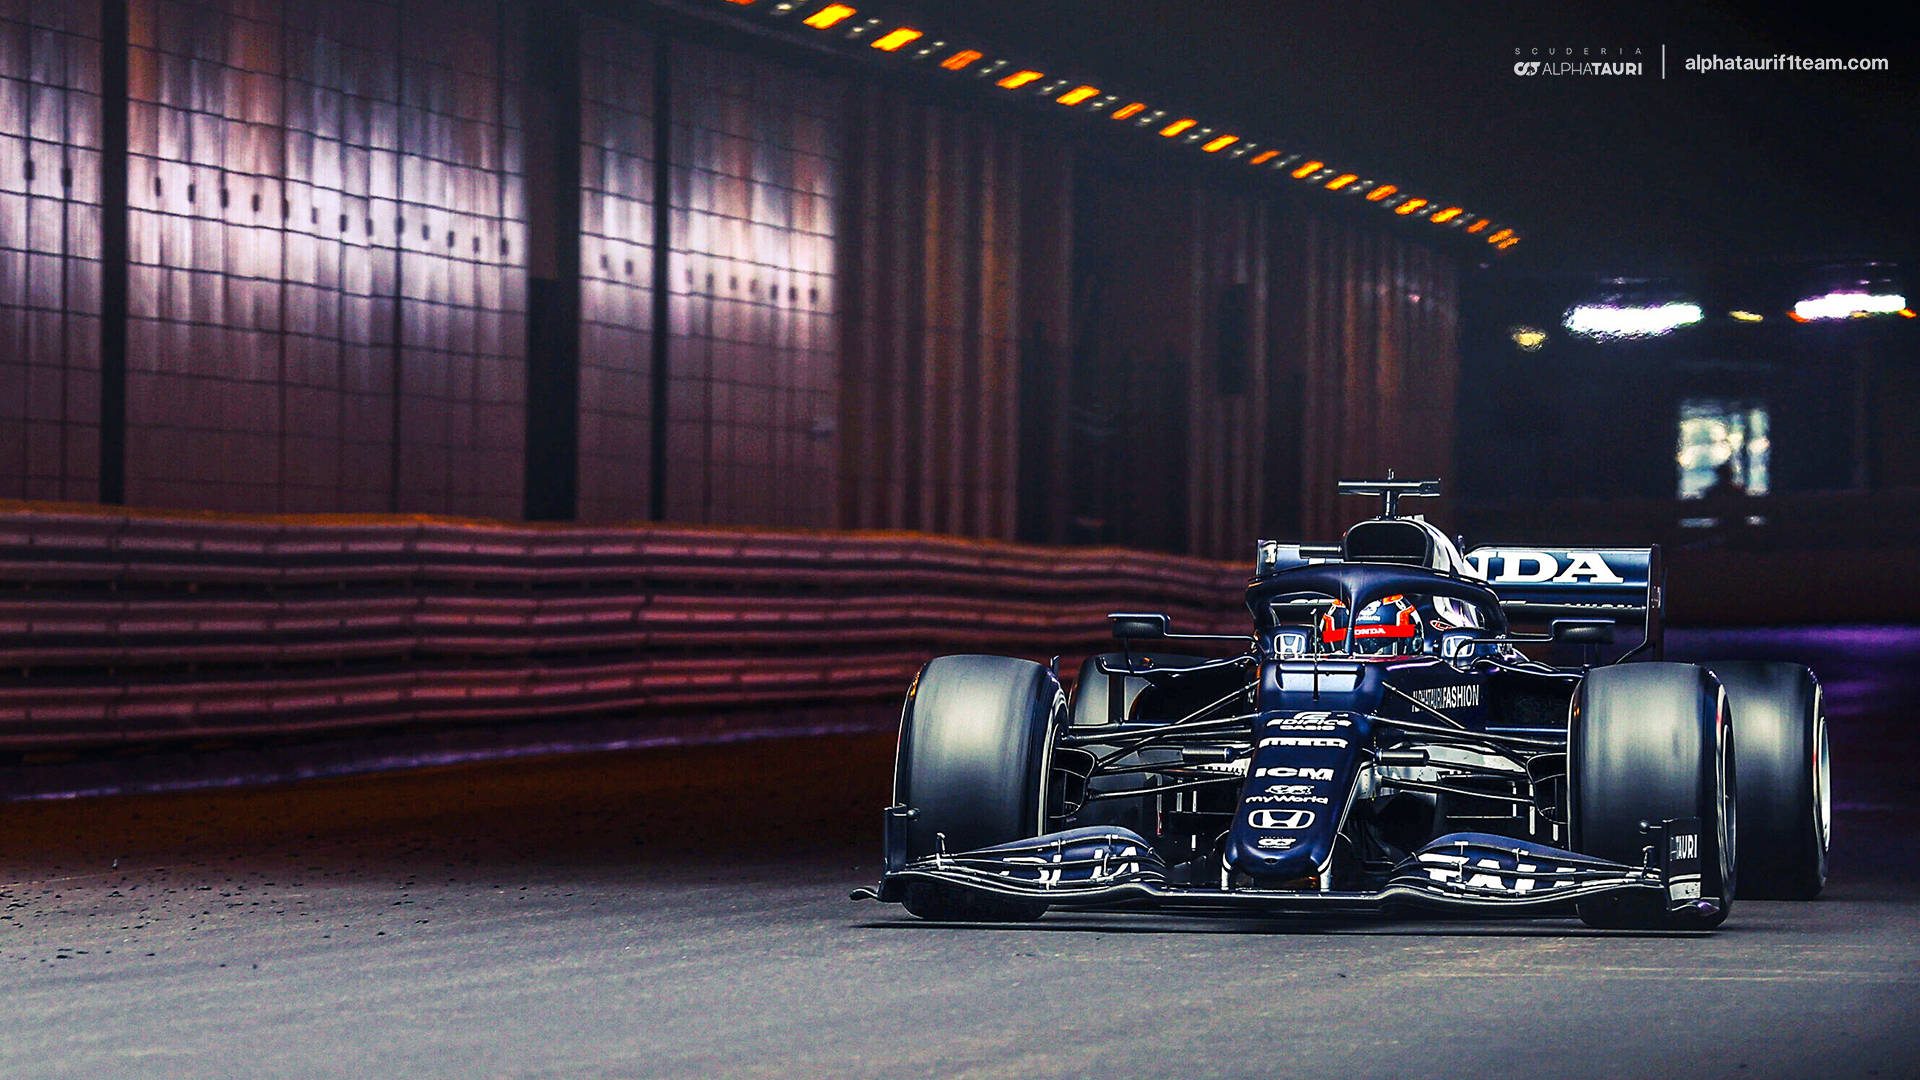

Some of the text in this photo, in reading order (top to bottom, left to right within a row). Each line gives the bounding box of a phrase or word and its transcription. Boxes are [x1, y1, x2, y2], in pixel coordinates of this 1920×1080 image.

[1463, 550, 1624, 584] NDA
[1354, 627, 1386, 636] ONDA
[1245, 794, 1329, 805] myWorld
